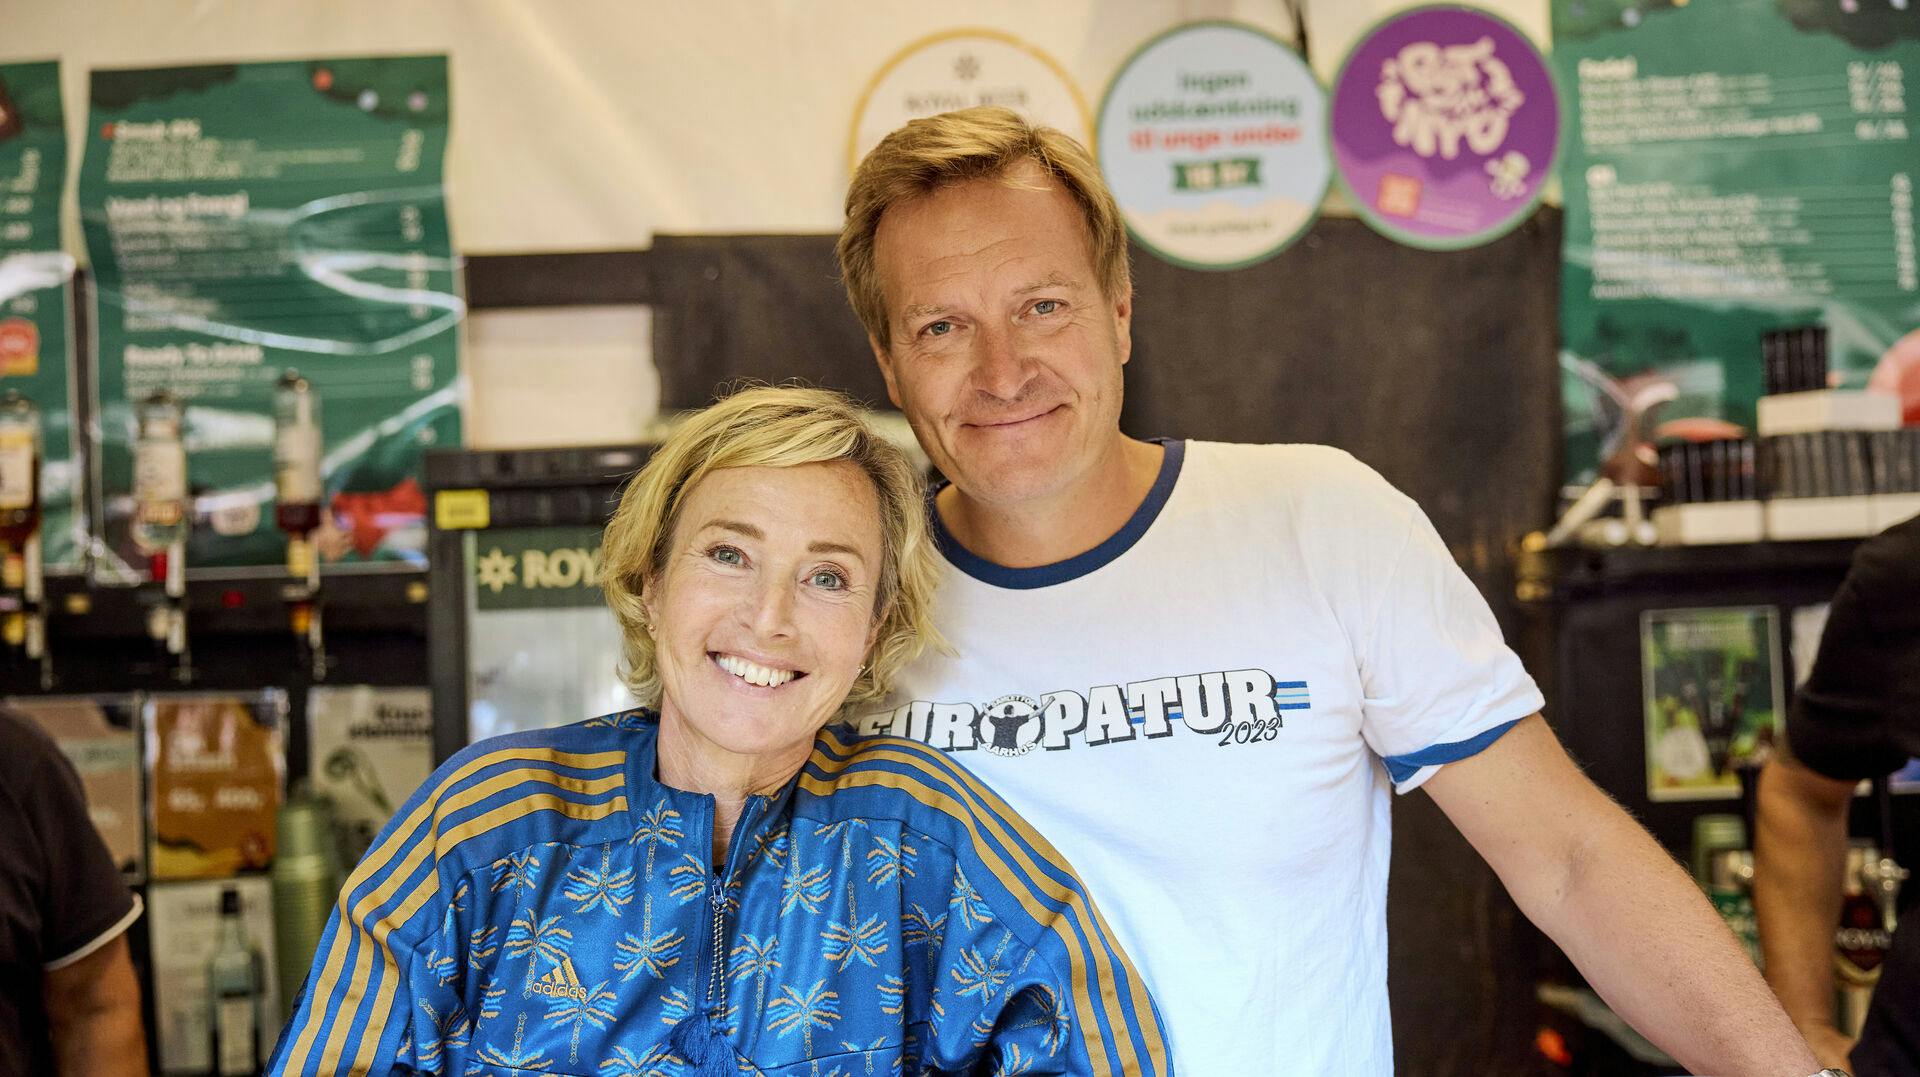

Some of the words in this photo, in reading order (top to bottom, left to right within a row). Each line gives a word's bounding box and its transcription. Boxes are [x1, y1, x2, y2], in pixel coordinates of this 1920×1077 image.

[1218, 717, 1280, 747] 2023
[980, 740, 1038, 758] AARHUS
[532, 982, 587, 999] adidas
